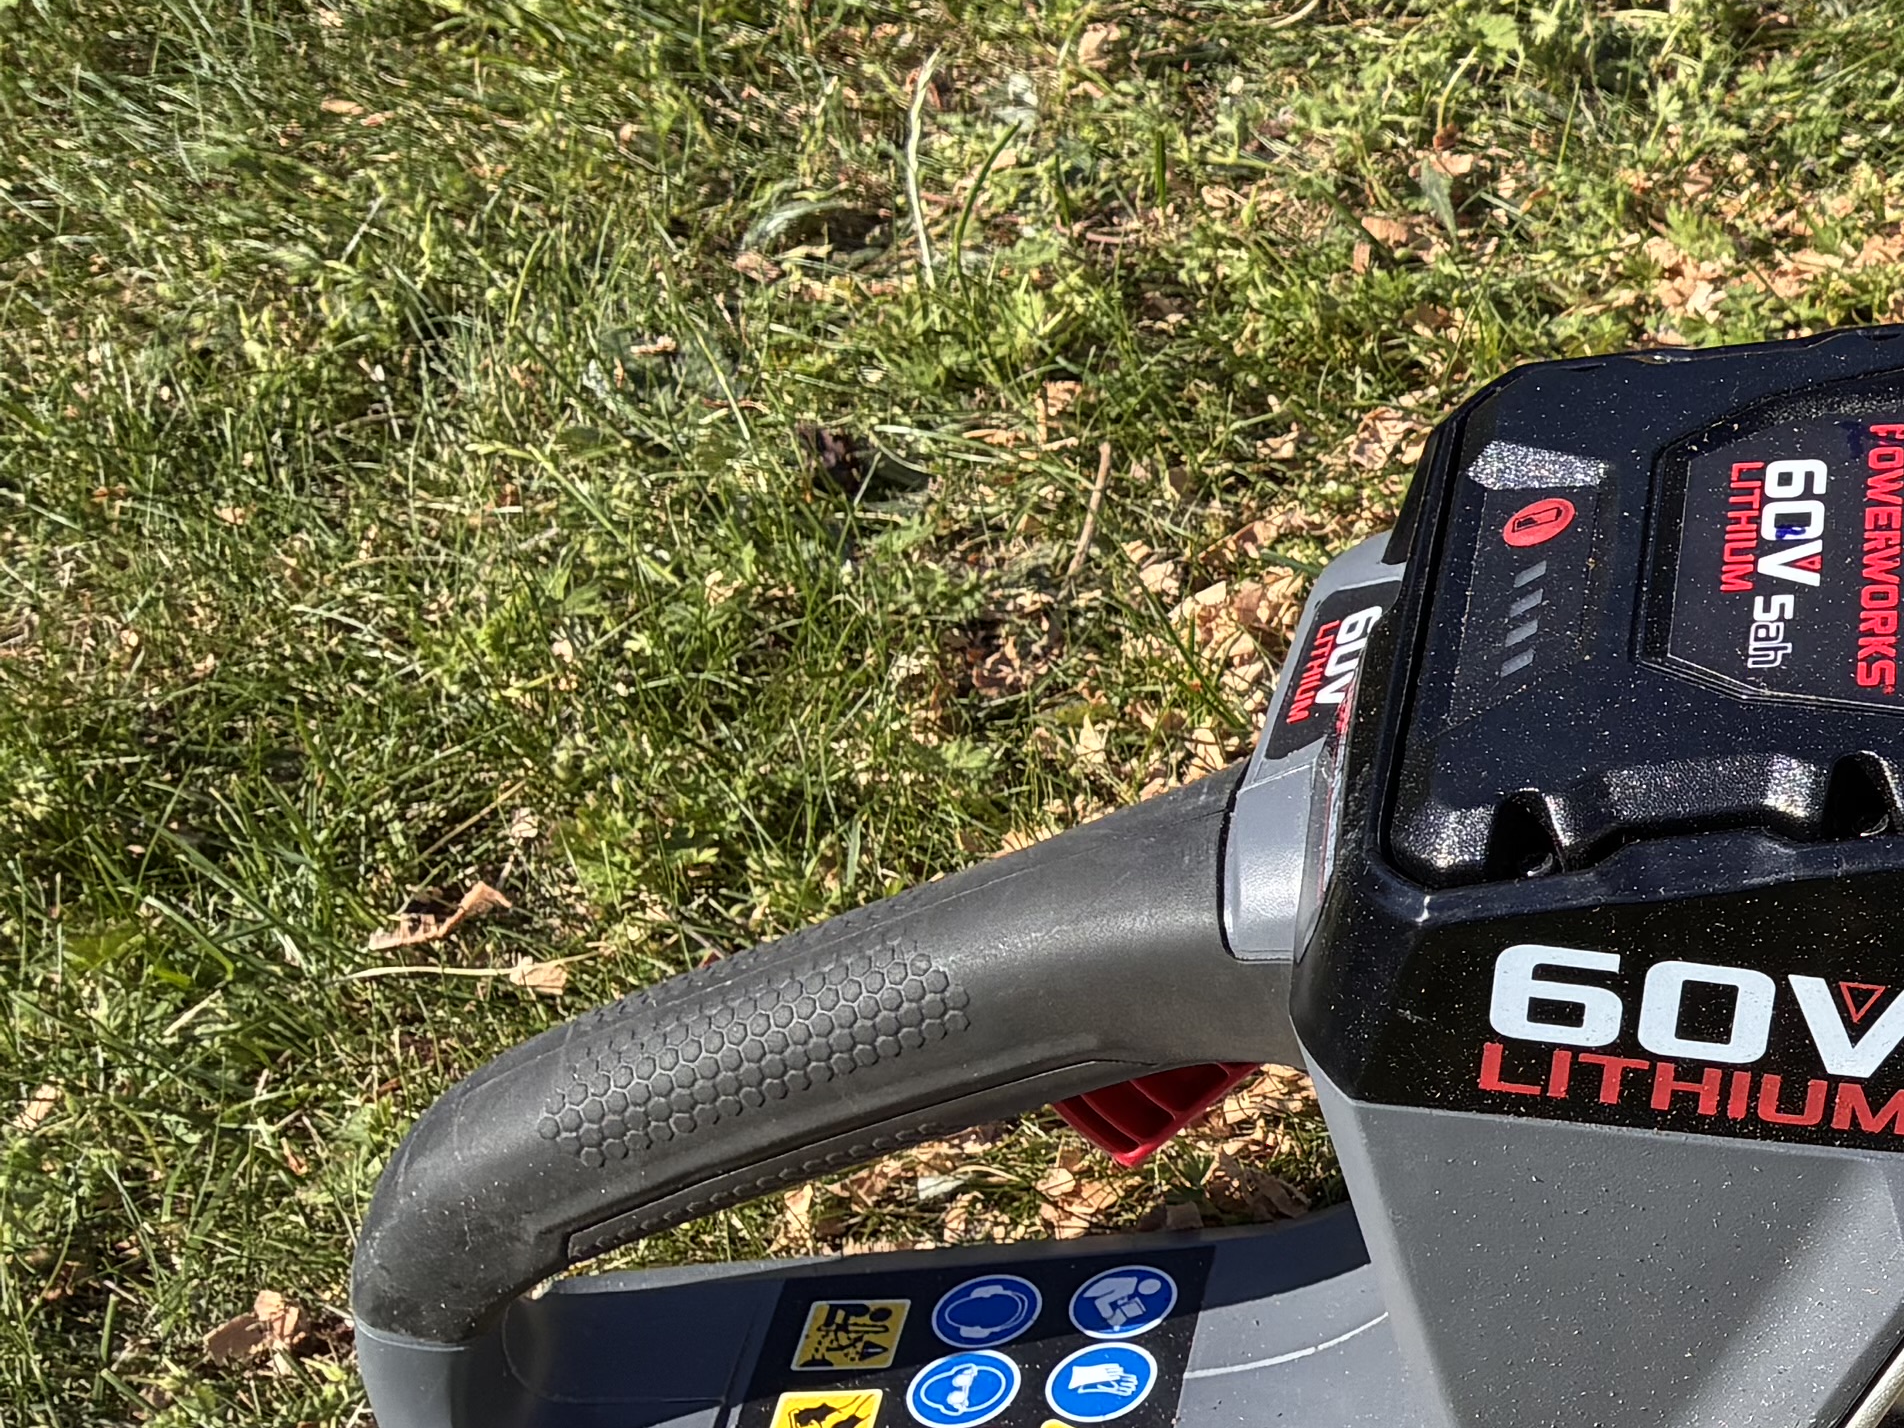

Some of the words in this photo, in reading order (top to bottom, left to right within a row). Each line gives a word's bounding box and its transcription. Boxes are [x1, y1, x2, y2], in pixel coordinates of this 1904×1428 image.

[1720, 461, 1765, 594] LITHIUM
[1757, 459, 1827, 587] 60V
[1286, 620, 1340, 724] LITHIUM
